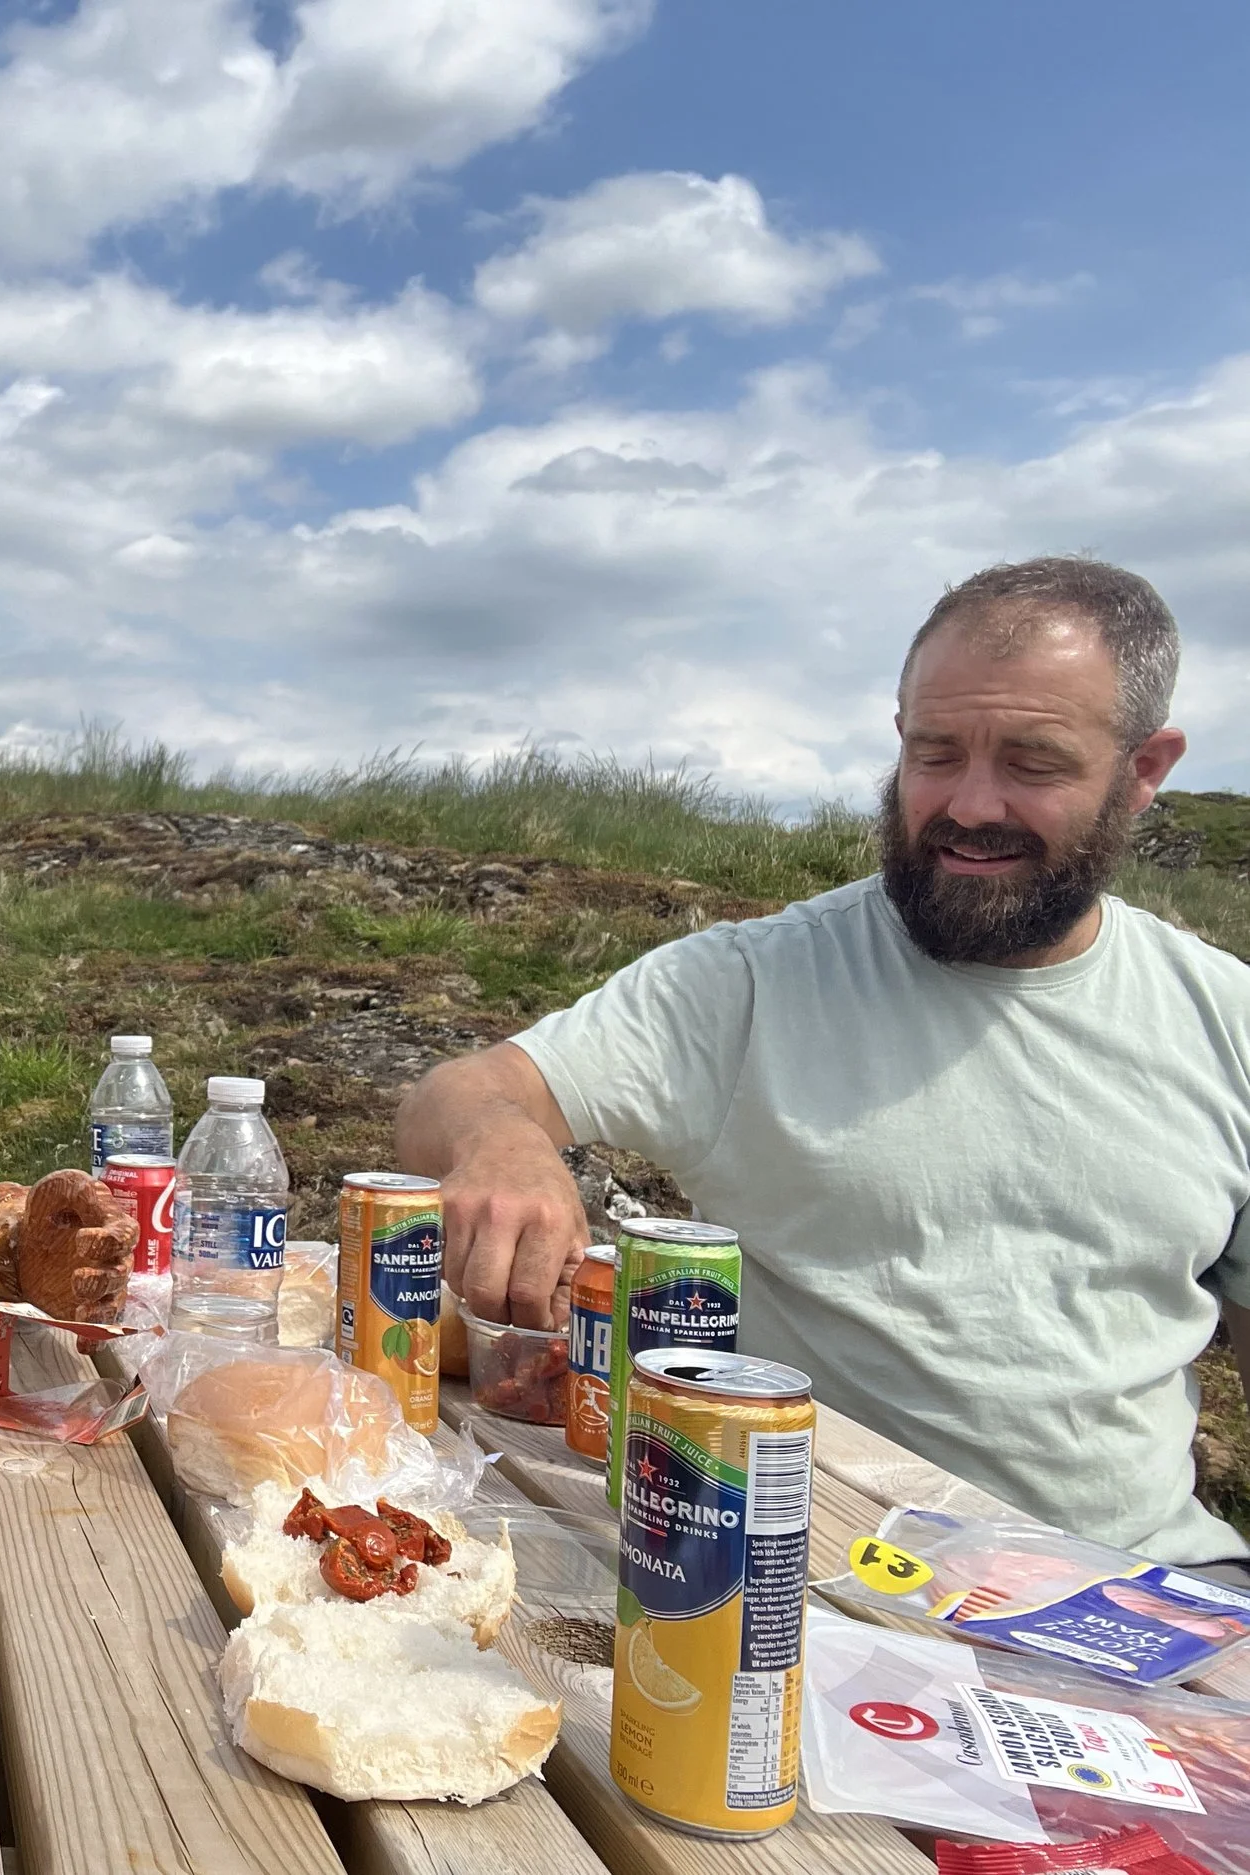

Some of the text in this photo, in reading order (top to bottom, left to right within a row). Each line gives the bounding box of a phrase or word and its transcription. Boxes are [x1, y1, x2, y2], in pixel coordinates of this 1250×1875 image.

[253, 1213, 285, 1248] IC
[648, 1273, 668, 1284] WITH
[668, 1268, 700, 1279] ITALIAN
[702, 1268, 722, 1280] FRUIT
[668, 1299, 685, 1307] DAL
[631, 1305, 739, 1328] SANPELLEGRINO
[641, 1323, 671, 1334] ITALIAN
[674, 1328, 716, 1337] SPARKLING
[653, 1420, 681, 1444] FRUIT
[681, 1442, 713, 1469] JUICE
[659, 1474, 680, 1488] 1932
[675, 1523, 719, 1540] DRINKS
[752, 1540, 777, 1549] Sparkling
[859, 1542, 921, 1578] £1
[745, 1586, 759, 1595] juice
[762, 1595, 779, 1603] carbon
[1034, 1622, 1164, 1661] Honey
[1056, 1618, 1168, 1652] Roast
[1083, 1614, 1172, 1644] HAM
[761, 1659, 771, 1667] and
[620, 1707, 656, 1737] SPARKLING
[621, 1720, 653, 1748] LEMON
[619, 1731, 654, 1760] BEVERAGE
[1035, 1712, 1085, 1759] CHORIZO
[997, 1729, 1040, 1778] JAMÓN
[628, 1774, 639, 1789] ml
